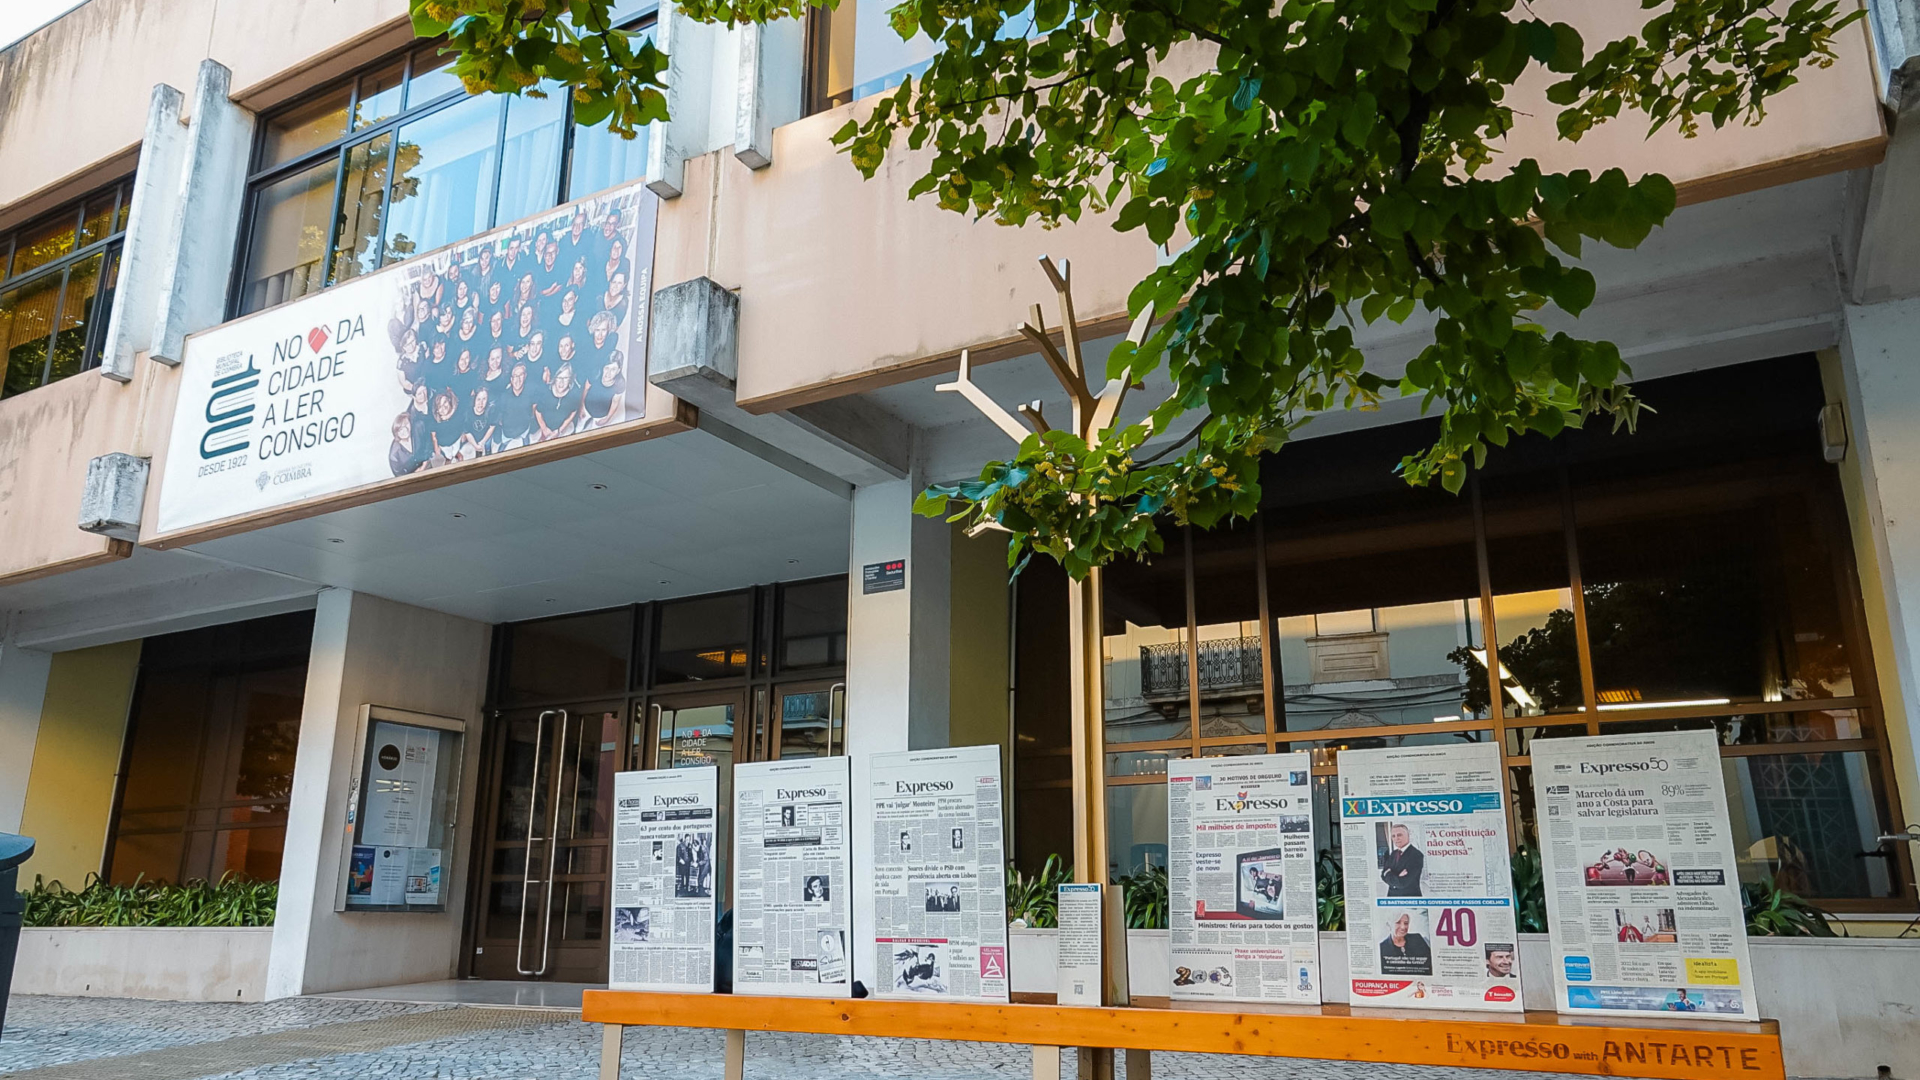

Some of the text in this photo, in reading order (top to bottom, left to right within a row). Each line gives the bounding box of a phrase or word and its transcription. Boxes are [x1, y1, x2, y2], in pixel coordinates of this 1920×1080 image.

[636, 267, 648, 343] A NOSSA EQUIPA
[272, 314, 365, 365] NO DA
[268, 350, 347, 396] CIDADE
[262, 389, 324, 429] A LER
[258, 412, 355, 460] CONSIGO
[198, 454, 248, 478] DESDE 1922
[273, 468, 312, 485] COIMBRA
[682, 728, 713, 739] NO DA
[682, 739, 707, 748] CIDADE
[687, 748, 701, 756] LER
[681, 756, 712, 766] CONSIGO
[1580, 757, 1668, 775] Expresso 50
[777, 788, 826, 801] Expresso
[896, 781, 953, 795] Expresso
[1576, 788, 1644, 799] Marcelo dá um
[1661, 784, 1685, 797] 89%
[653, 795, 699, 808] Expresso
[1216, 798, 1288, 813] Expresso
[1367, 799, 1463, 817] Expresso
[1576, 800, 1594, 808] ano
[1603, 799, 1629, 807] Costa
[1631, 799, 1654, 809] para
[1577, 807, 1659, 818] salvar legislatura
[1208, 823, 1235, 831] milhões
[1246, 823, 1277, 831] impostos
[1439, 829, 1496, 838] Constituição
[1426, 838, 1465, 847] não está
[907, 873, 935, 881] presidência
[1436, 907, 1477, 947] 40
[1355, 982, 1388, 990] POUPANÇA
[1446, 1032, 1762, 1071] Expresso with ANTARTE
